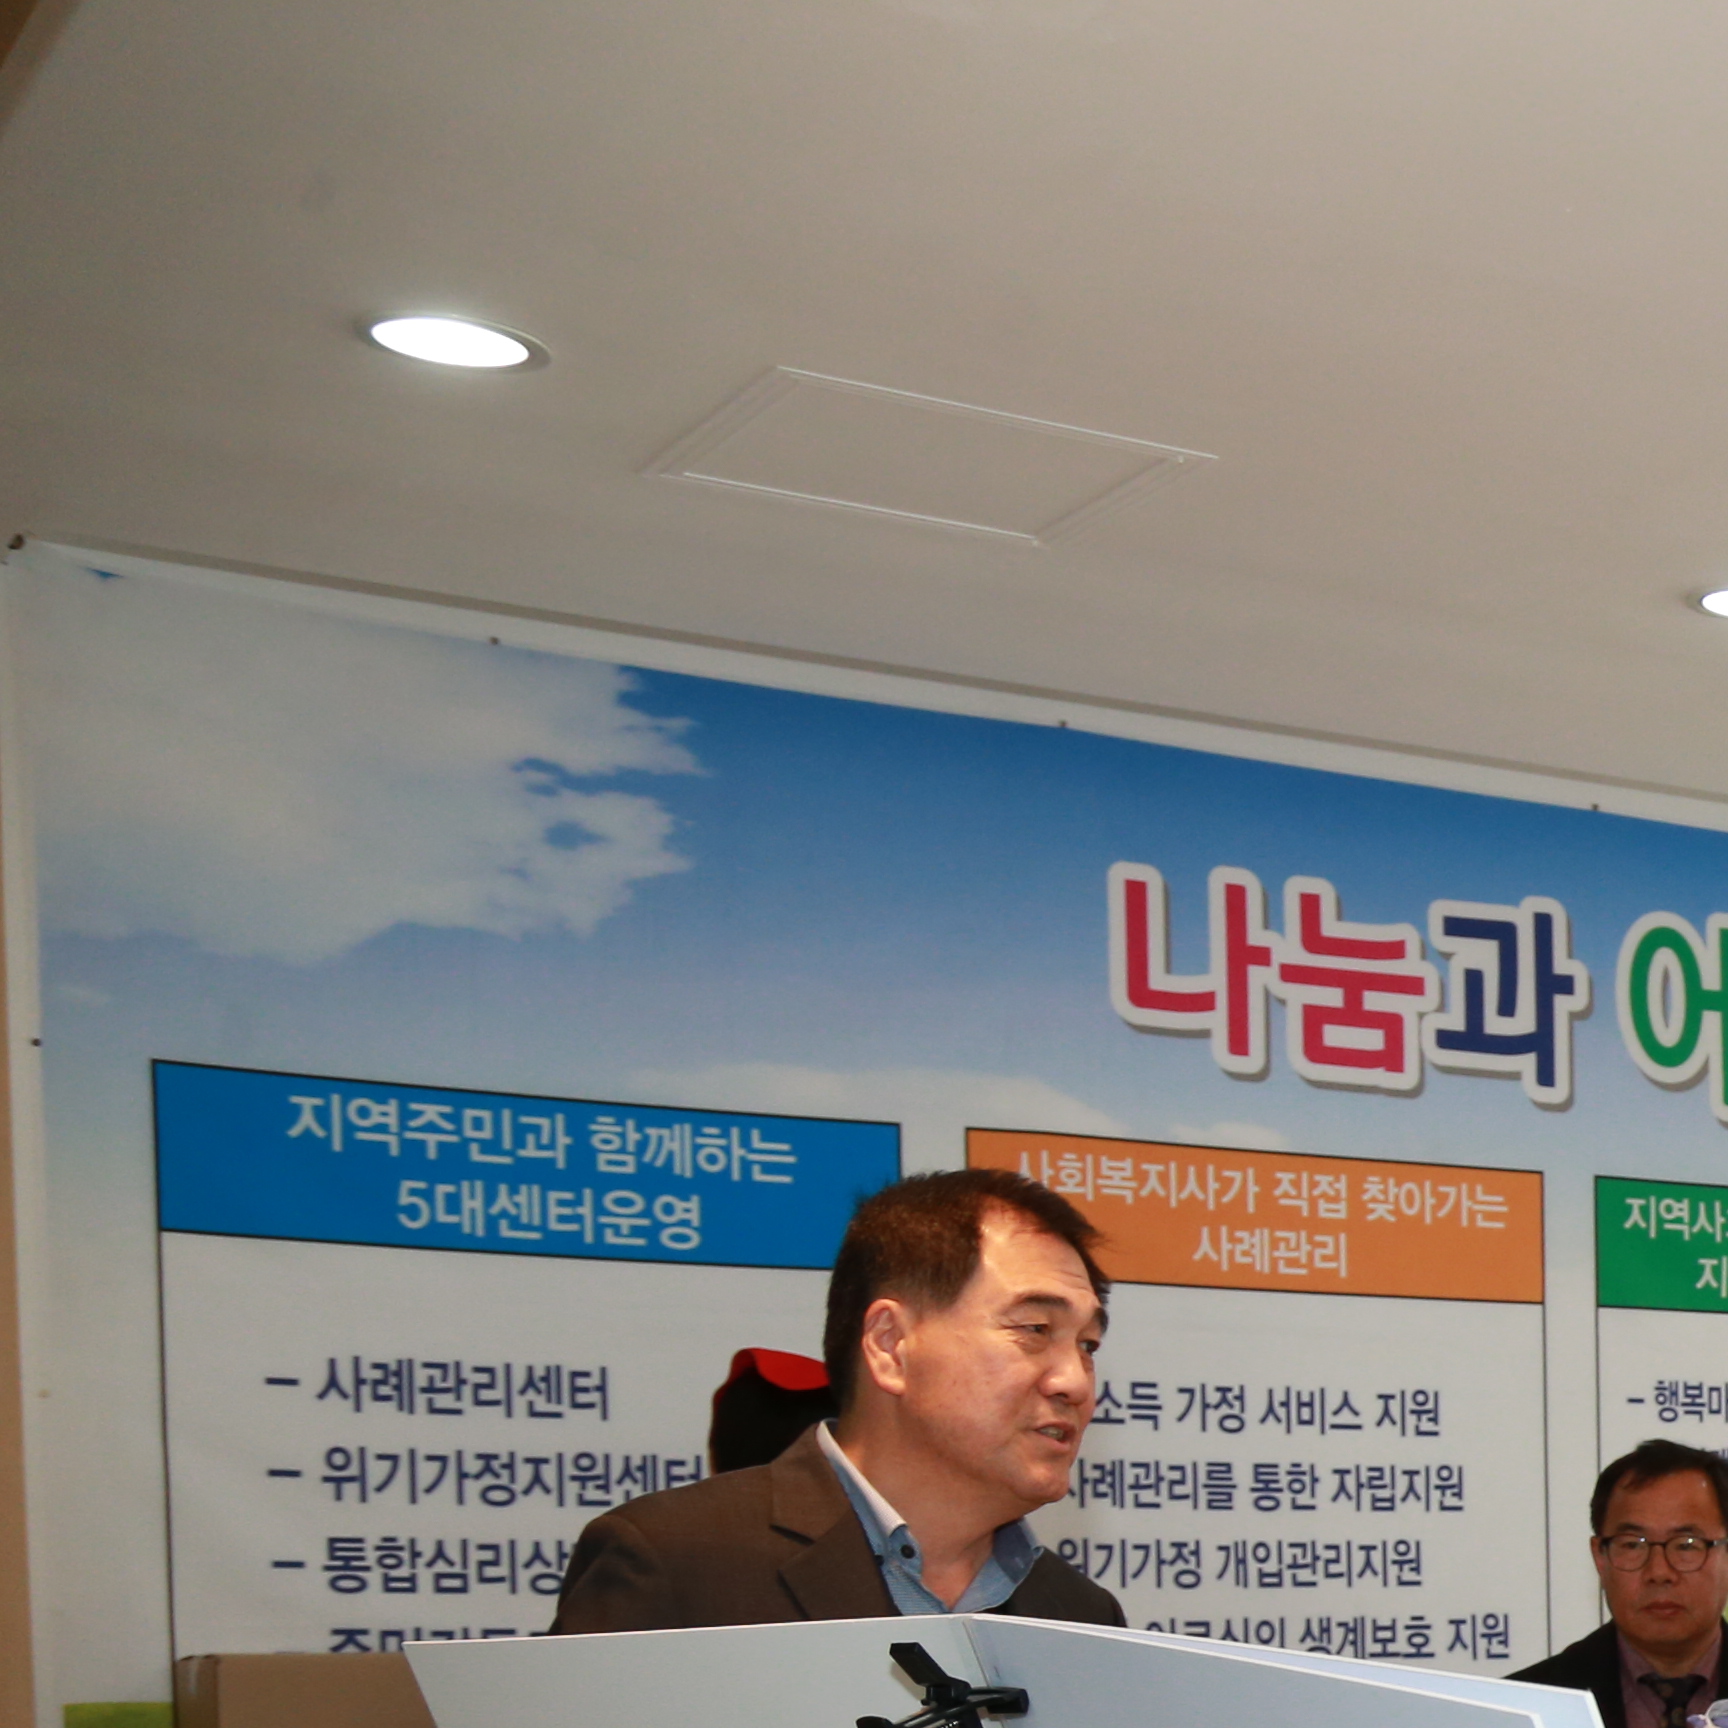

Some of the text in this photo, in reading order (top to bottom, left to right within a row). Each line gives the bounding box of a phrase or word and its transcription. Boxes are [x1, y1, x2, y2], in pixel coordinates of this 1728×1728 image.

[1116, 870, 1582, 1097] 나눔과
[286, 1093, 797, 1184] 지역주민과 함께하는
[397, 1180, 700, 1251] 5대센터운영
[1018, 1150, 1509, 1229] 사회복지사가 직접 찾아가는
[1192, 1225, 1347, 1279] 사례관리
[316, 1356, 609, 1421] 사례관리센터
[1089, 1381, 1440, 1437] 소득 가정 서비스 지원
[1249, 1463, 1320, 1511] 통한
[1331, 1464, 1465, 1512] 자립지원
[322, 1537, 570, 1595] 통합심리상
[1216, 1539, 1423, 1588] 개입관리지원
[1299, 1615, 1435, 1659] 생계보호
[1448, 1613, 1511, 1661] 지원
